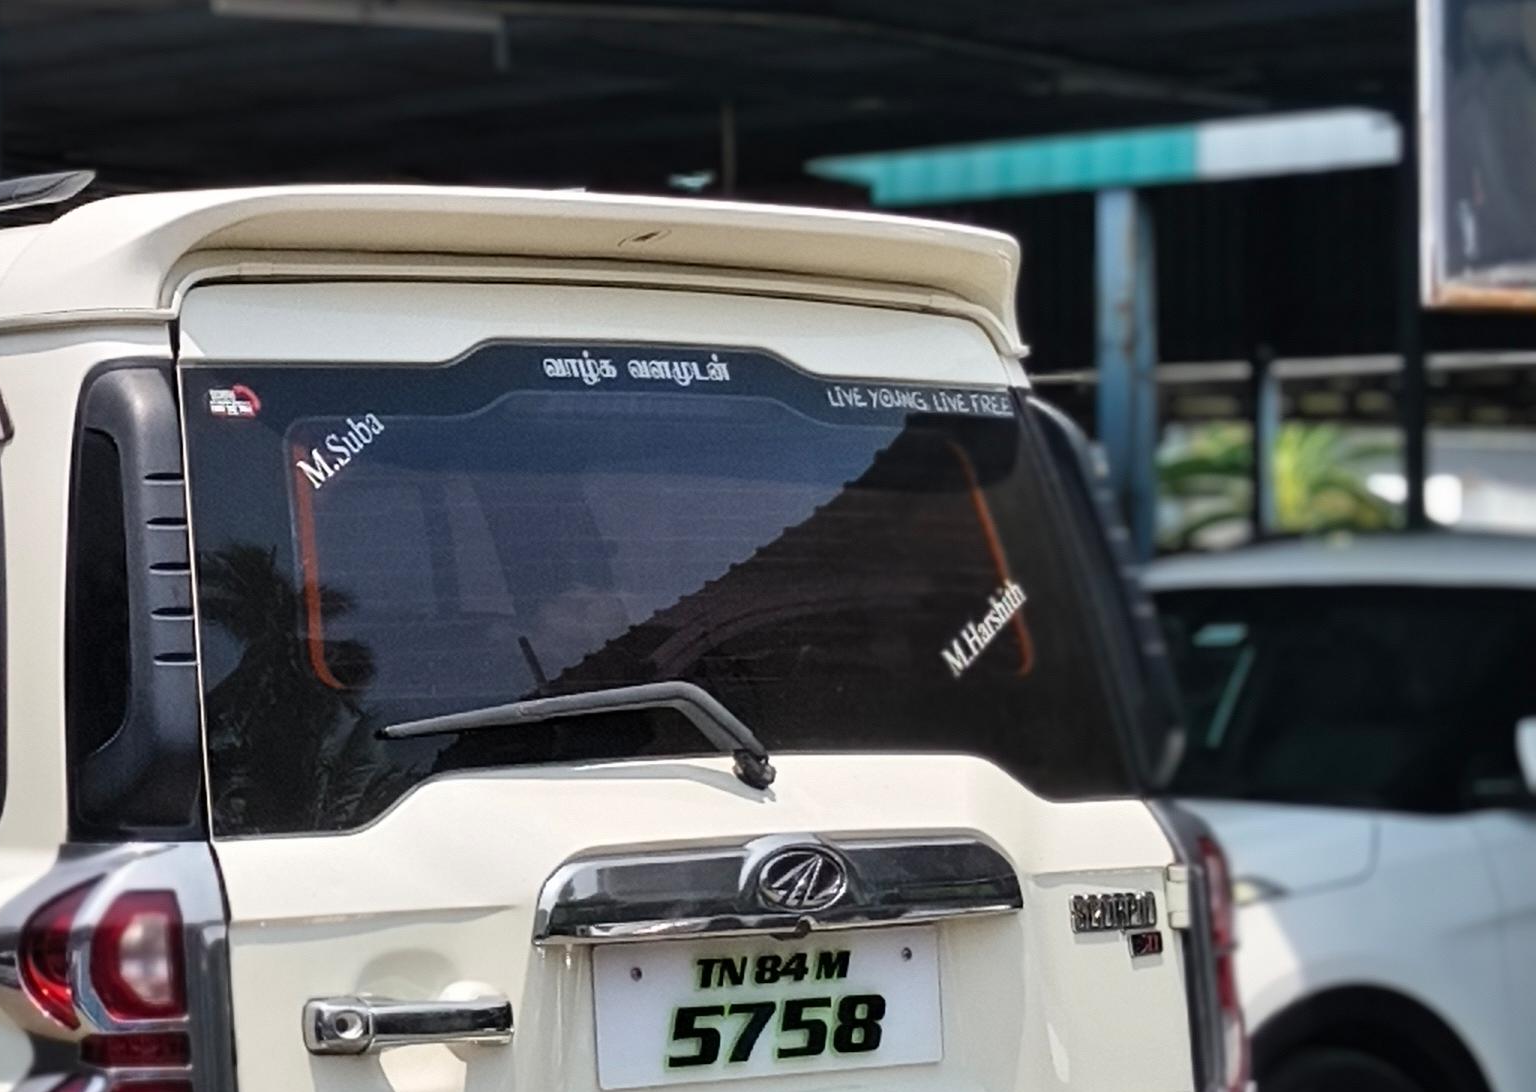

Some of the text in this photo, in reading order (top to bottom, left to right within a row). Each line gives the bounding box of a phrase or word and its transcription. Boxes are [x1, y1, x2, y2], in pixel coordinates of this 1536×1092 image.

[827, 386, 867, 408] LIVE
[932, 392, 970, 413] LIVE
[969, 394, 1015, 416] FREE
[296, 413, 384, 488] M.Suba
[696, 950, 851, 989] TN 84 M
[668, 994, 887, 1068] 5758
